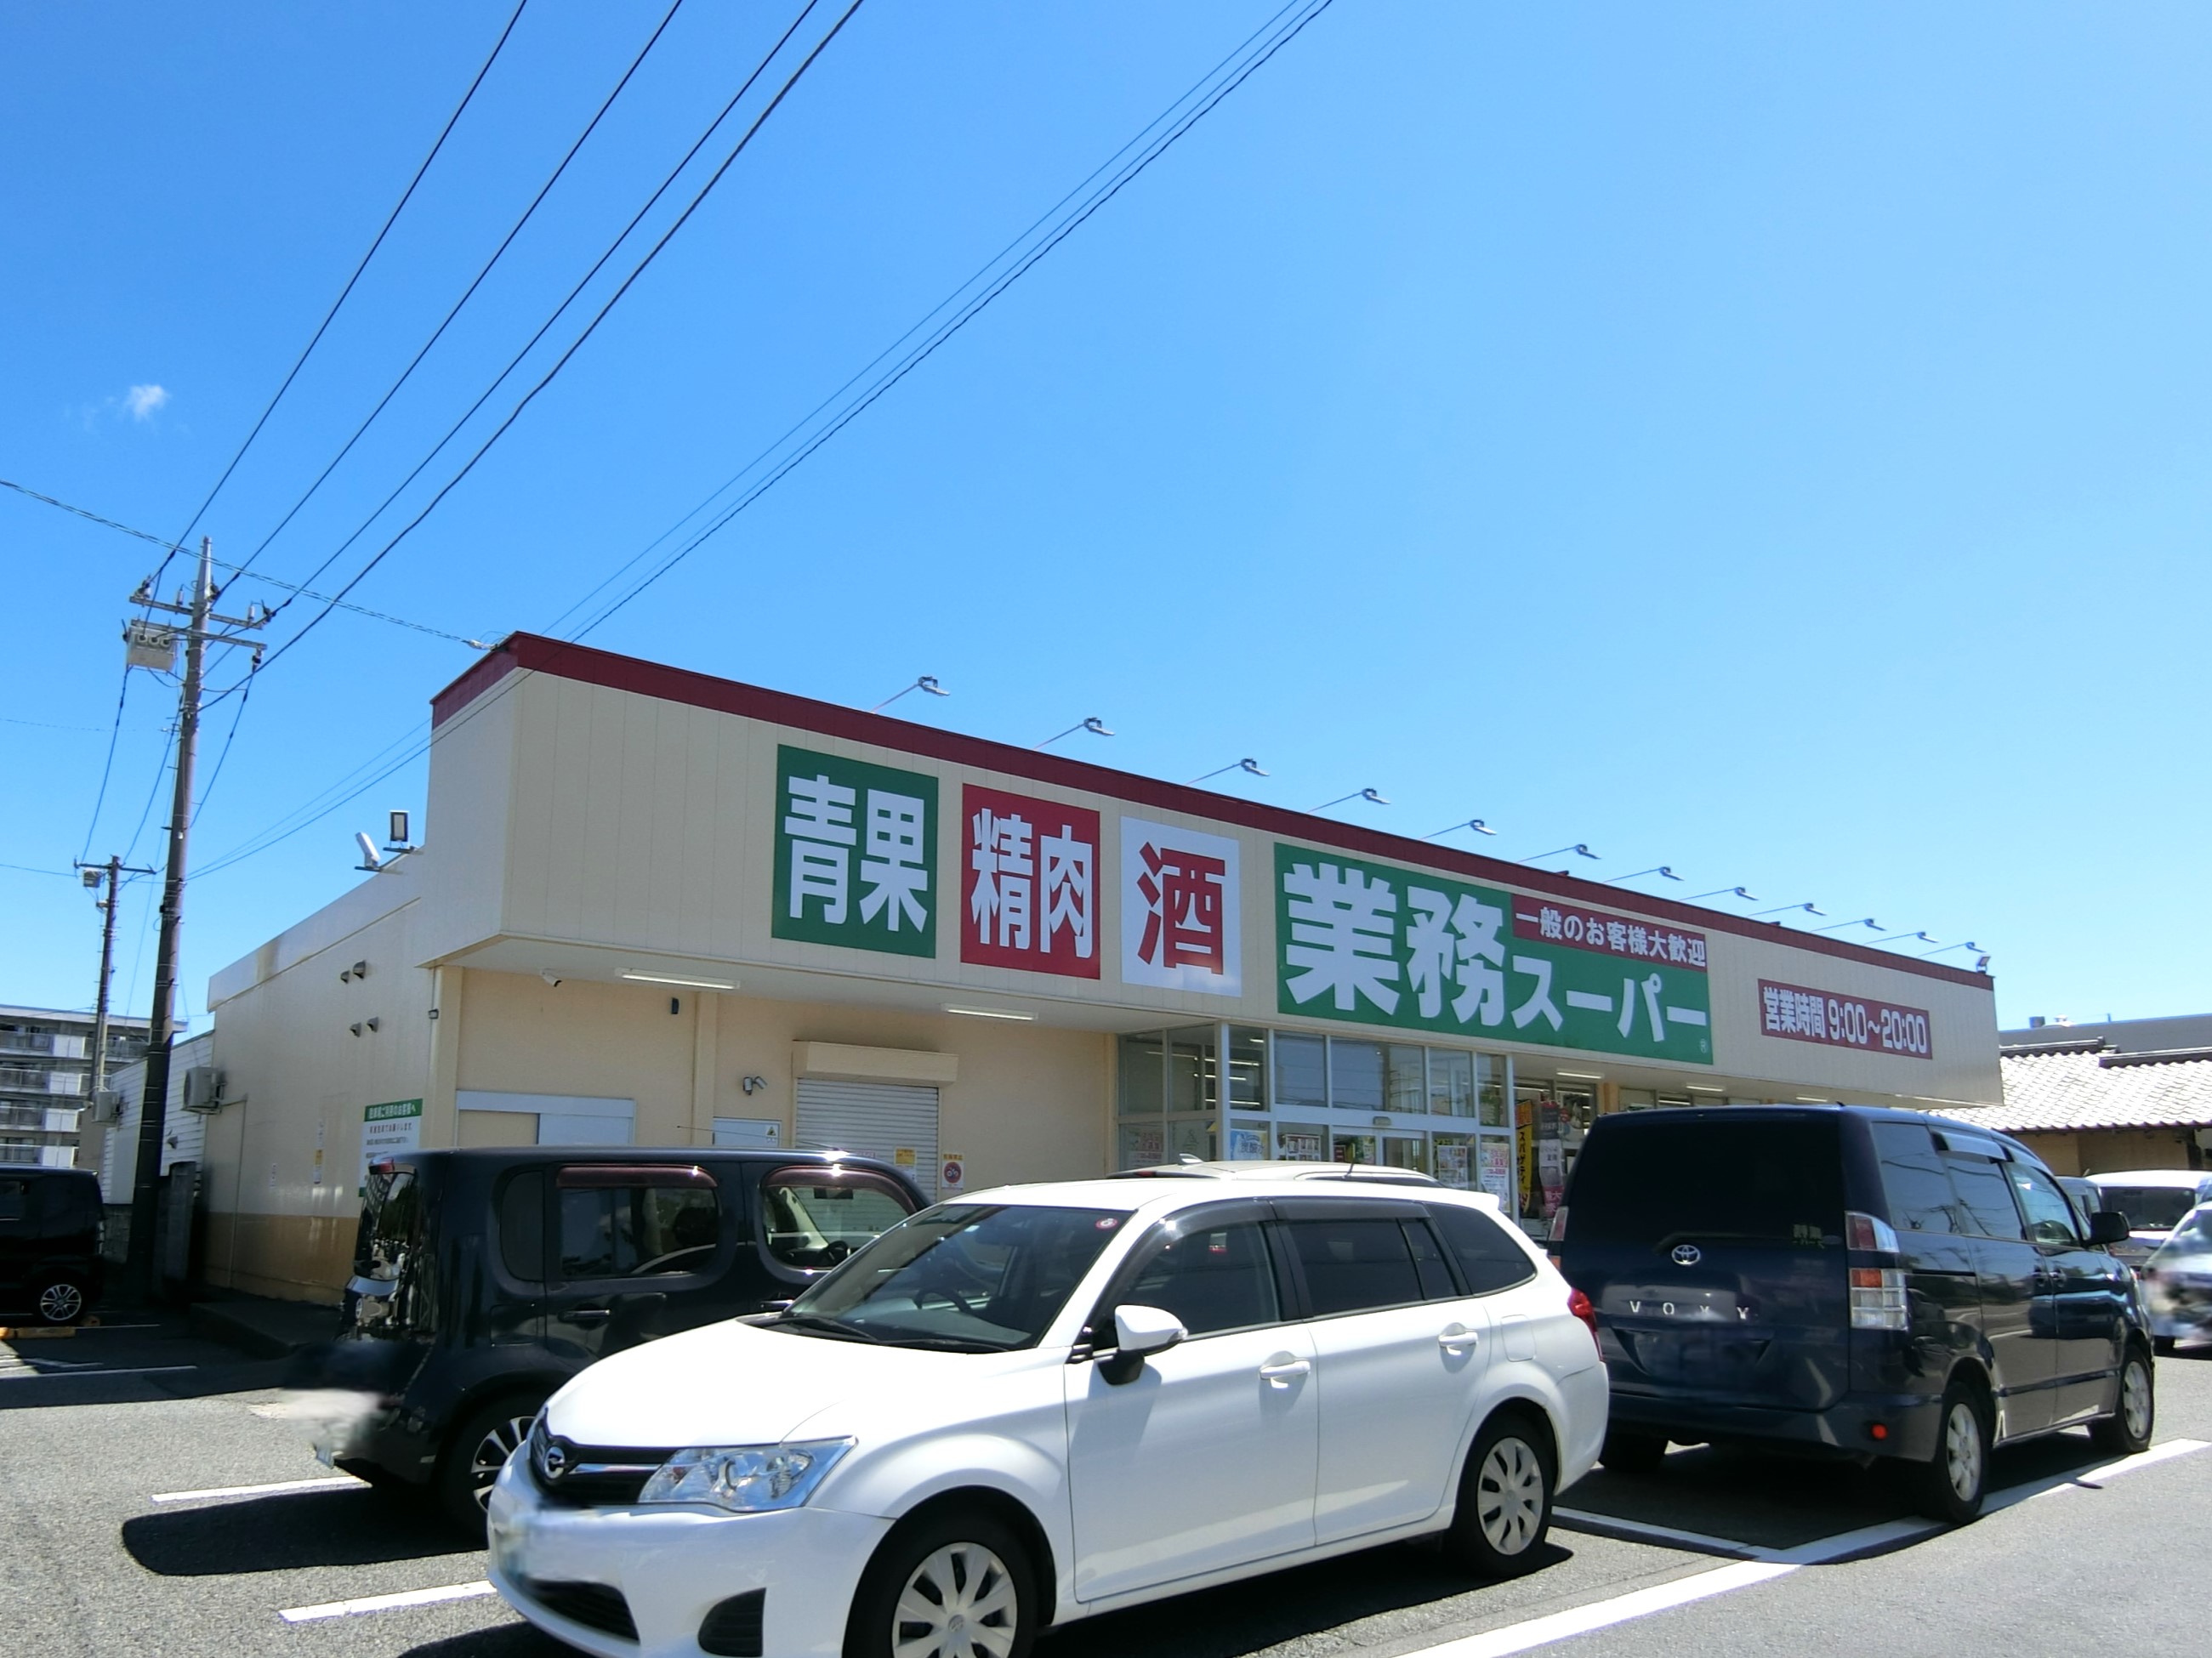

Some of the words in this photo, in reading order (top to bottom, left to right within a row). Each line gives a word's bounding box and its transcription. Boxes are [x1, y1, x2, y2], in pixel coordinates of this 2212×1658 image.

[784, 775, 929, 934] 青果
[970, 808, 1093, 959] 精肉
[1136, 841, 1226, 975] 酒
[1283, 862, 1707, 1042] 業務スーパー
[1515, 906, 1706, 968] 一般のお客様大歓迎
[1764, 986, 1827, 1039] 営業時間
